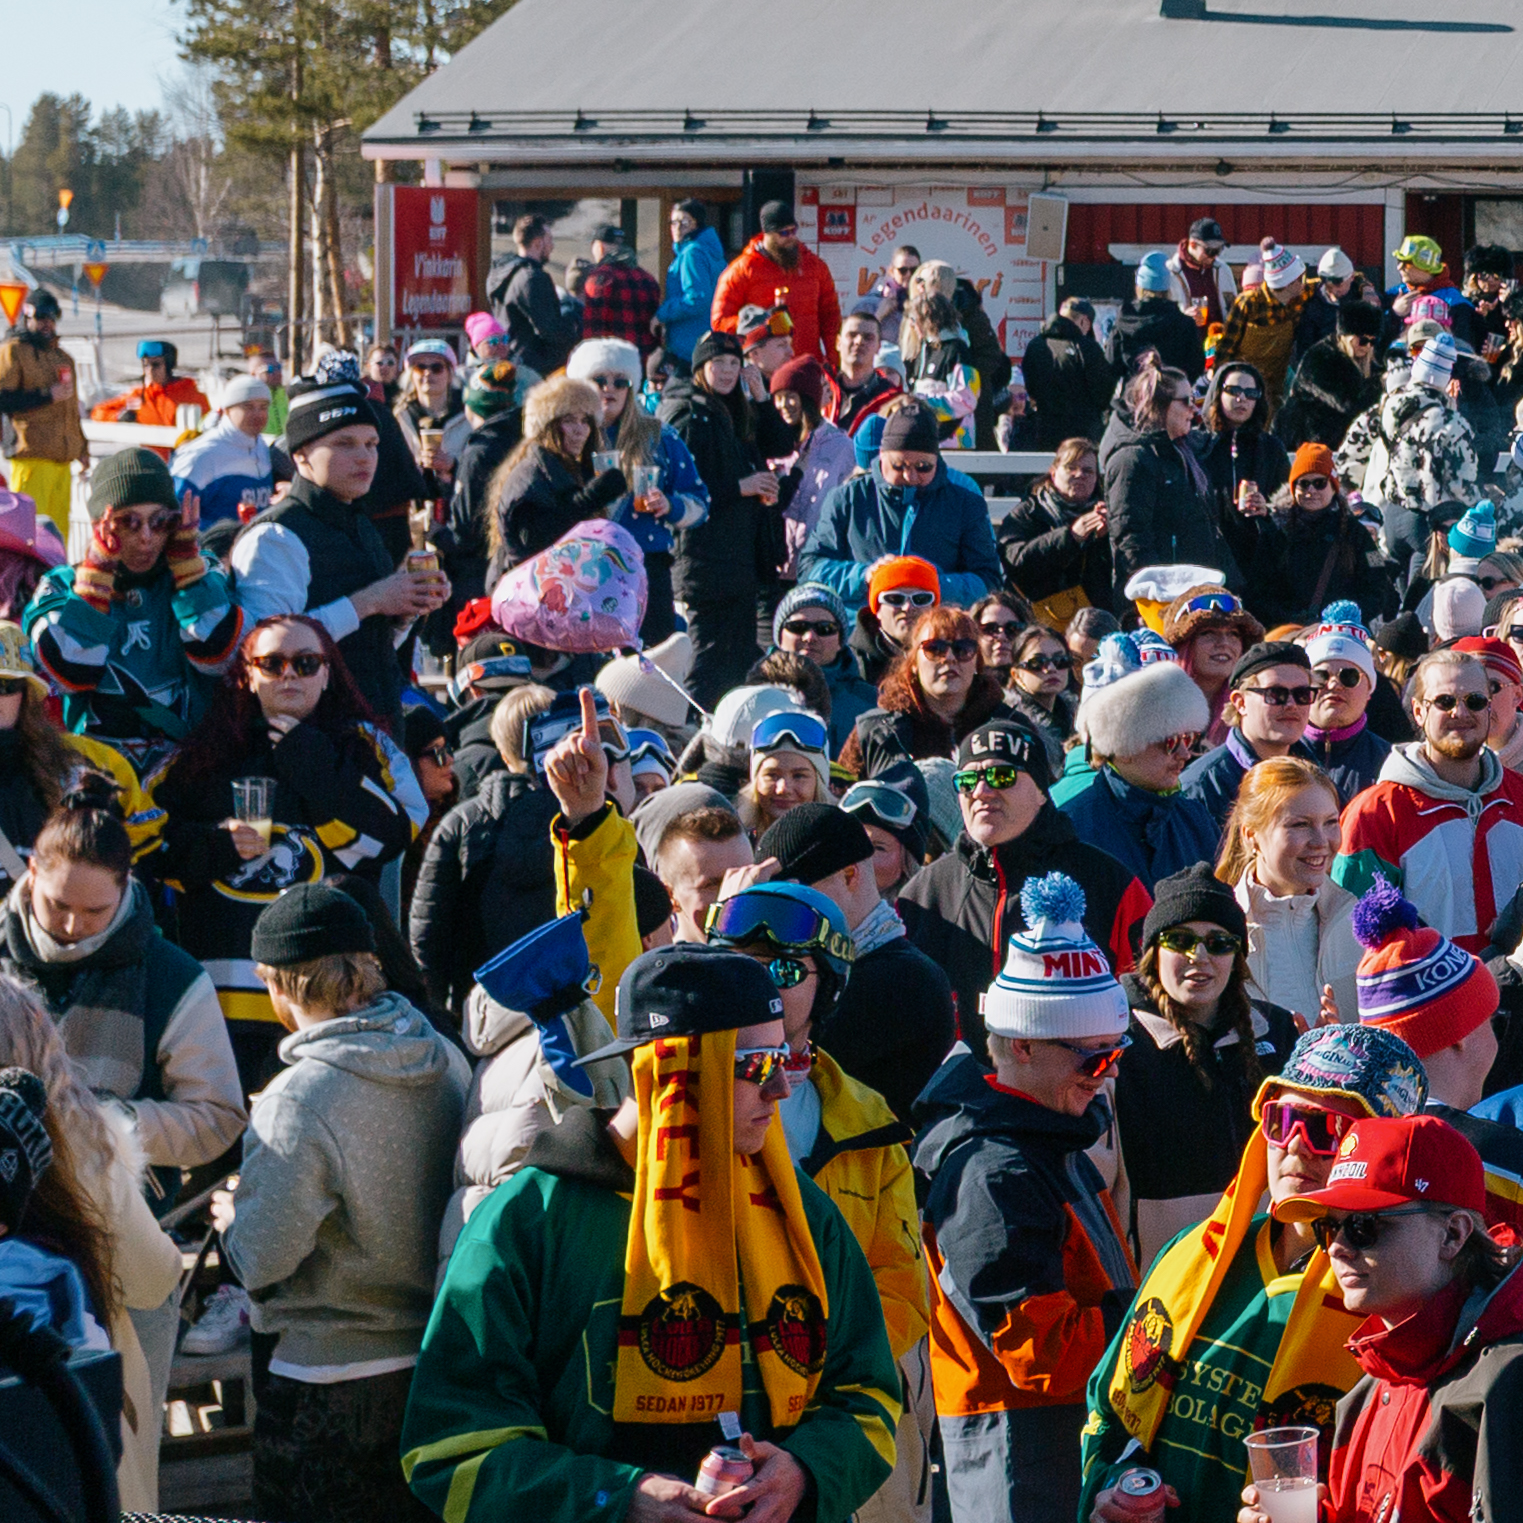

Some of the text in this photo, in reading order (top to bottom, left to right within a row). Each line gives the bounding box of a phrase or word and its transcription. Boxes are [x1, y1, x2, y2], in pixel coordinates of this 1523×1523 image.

[860, 202, 999, 257] Legendaarinen
[636, 1393, 726, 1413] SEDAN 1977
